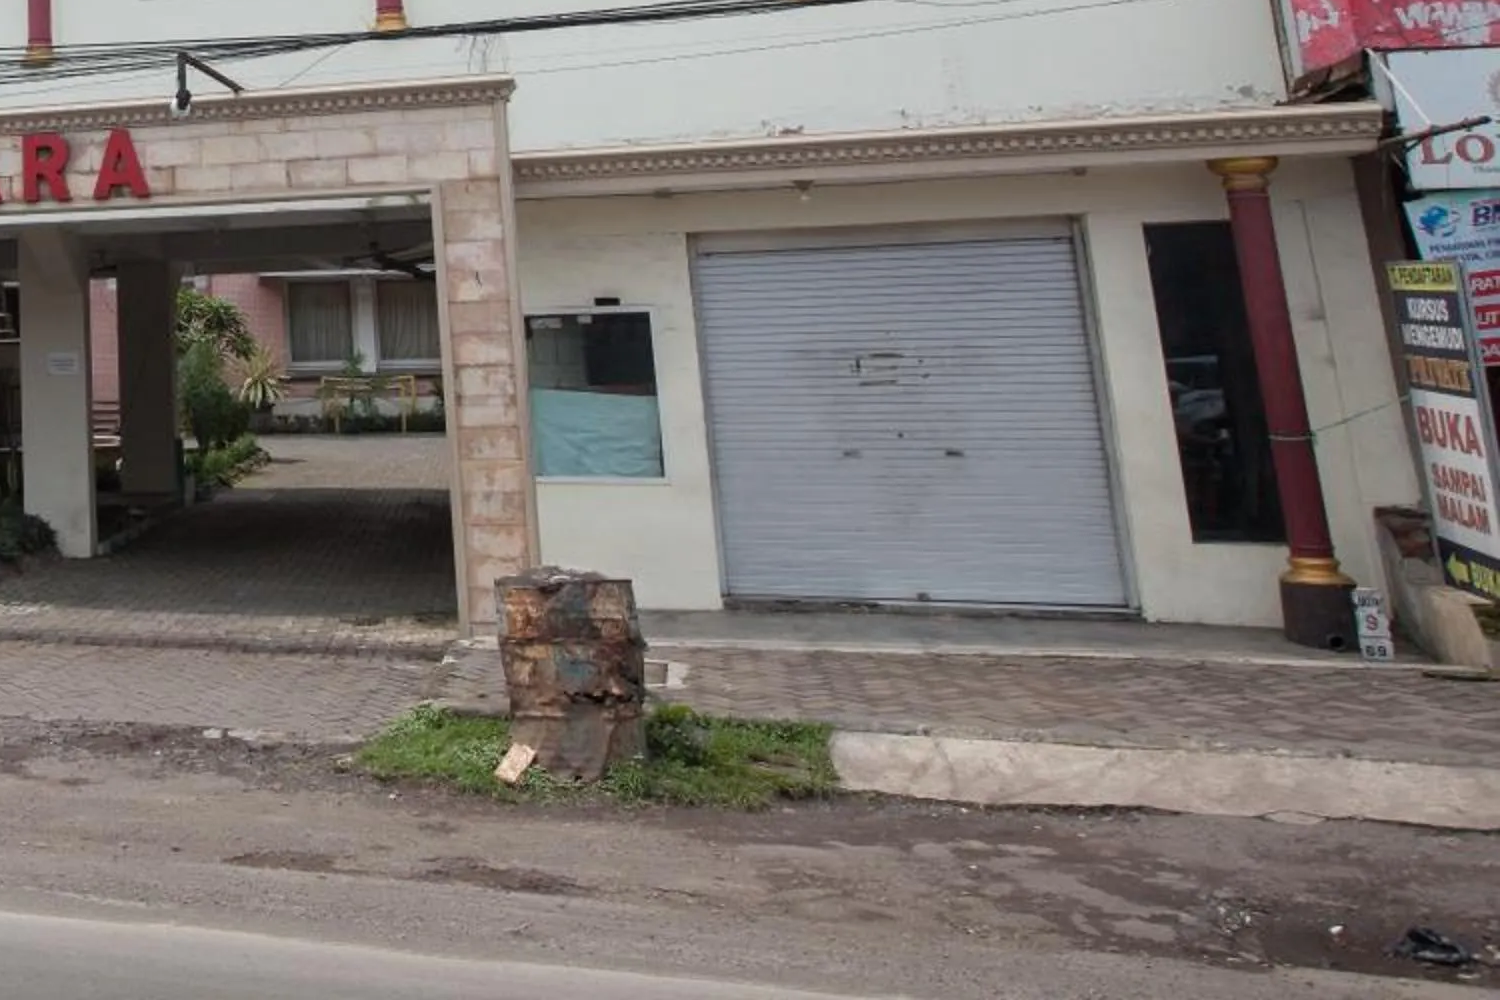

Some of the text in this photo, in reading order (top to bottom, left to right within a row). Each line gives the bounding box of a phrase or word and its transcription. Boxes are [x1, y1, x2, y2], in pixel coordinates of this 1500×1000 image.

[1417, 406, 1484, 459] BUKA
[1431, 463, 1487, 503] SAMPAI
[1437, 493, 1492, 536] MALAM
